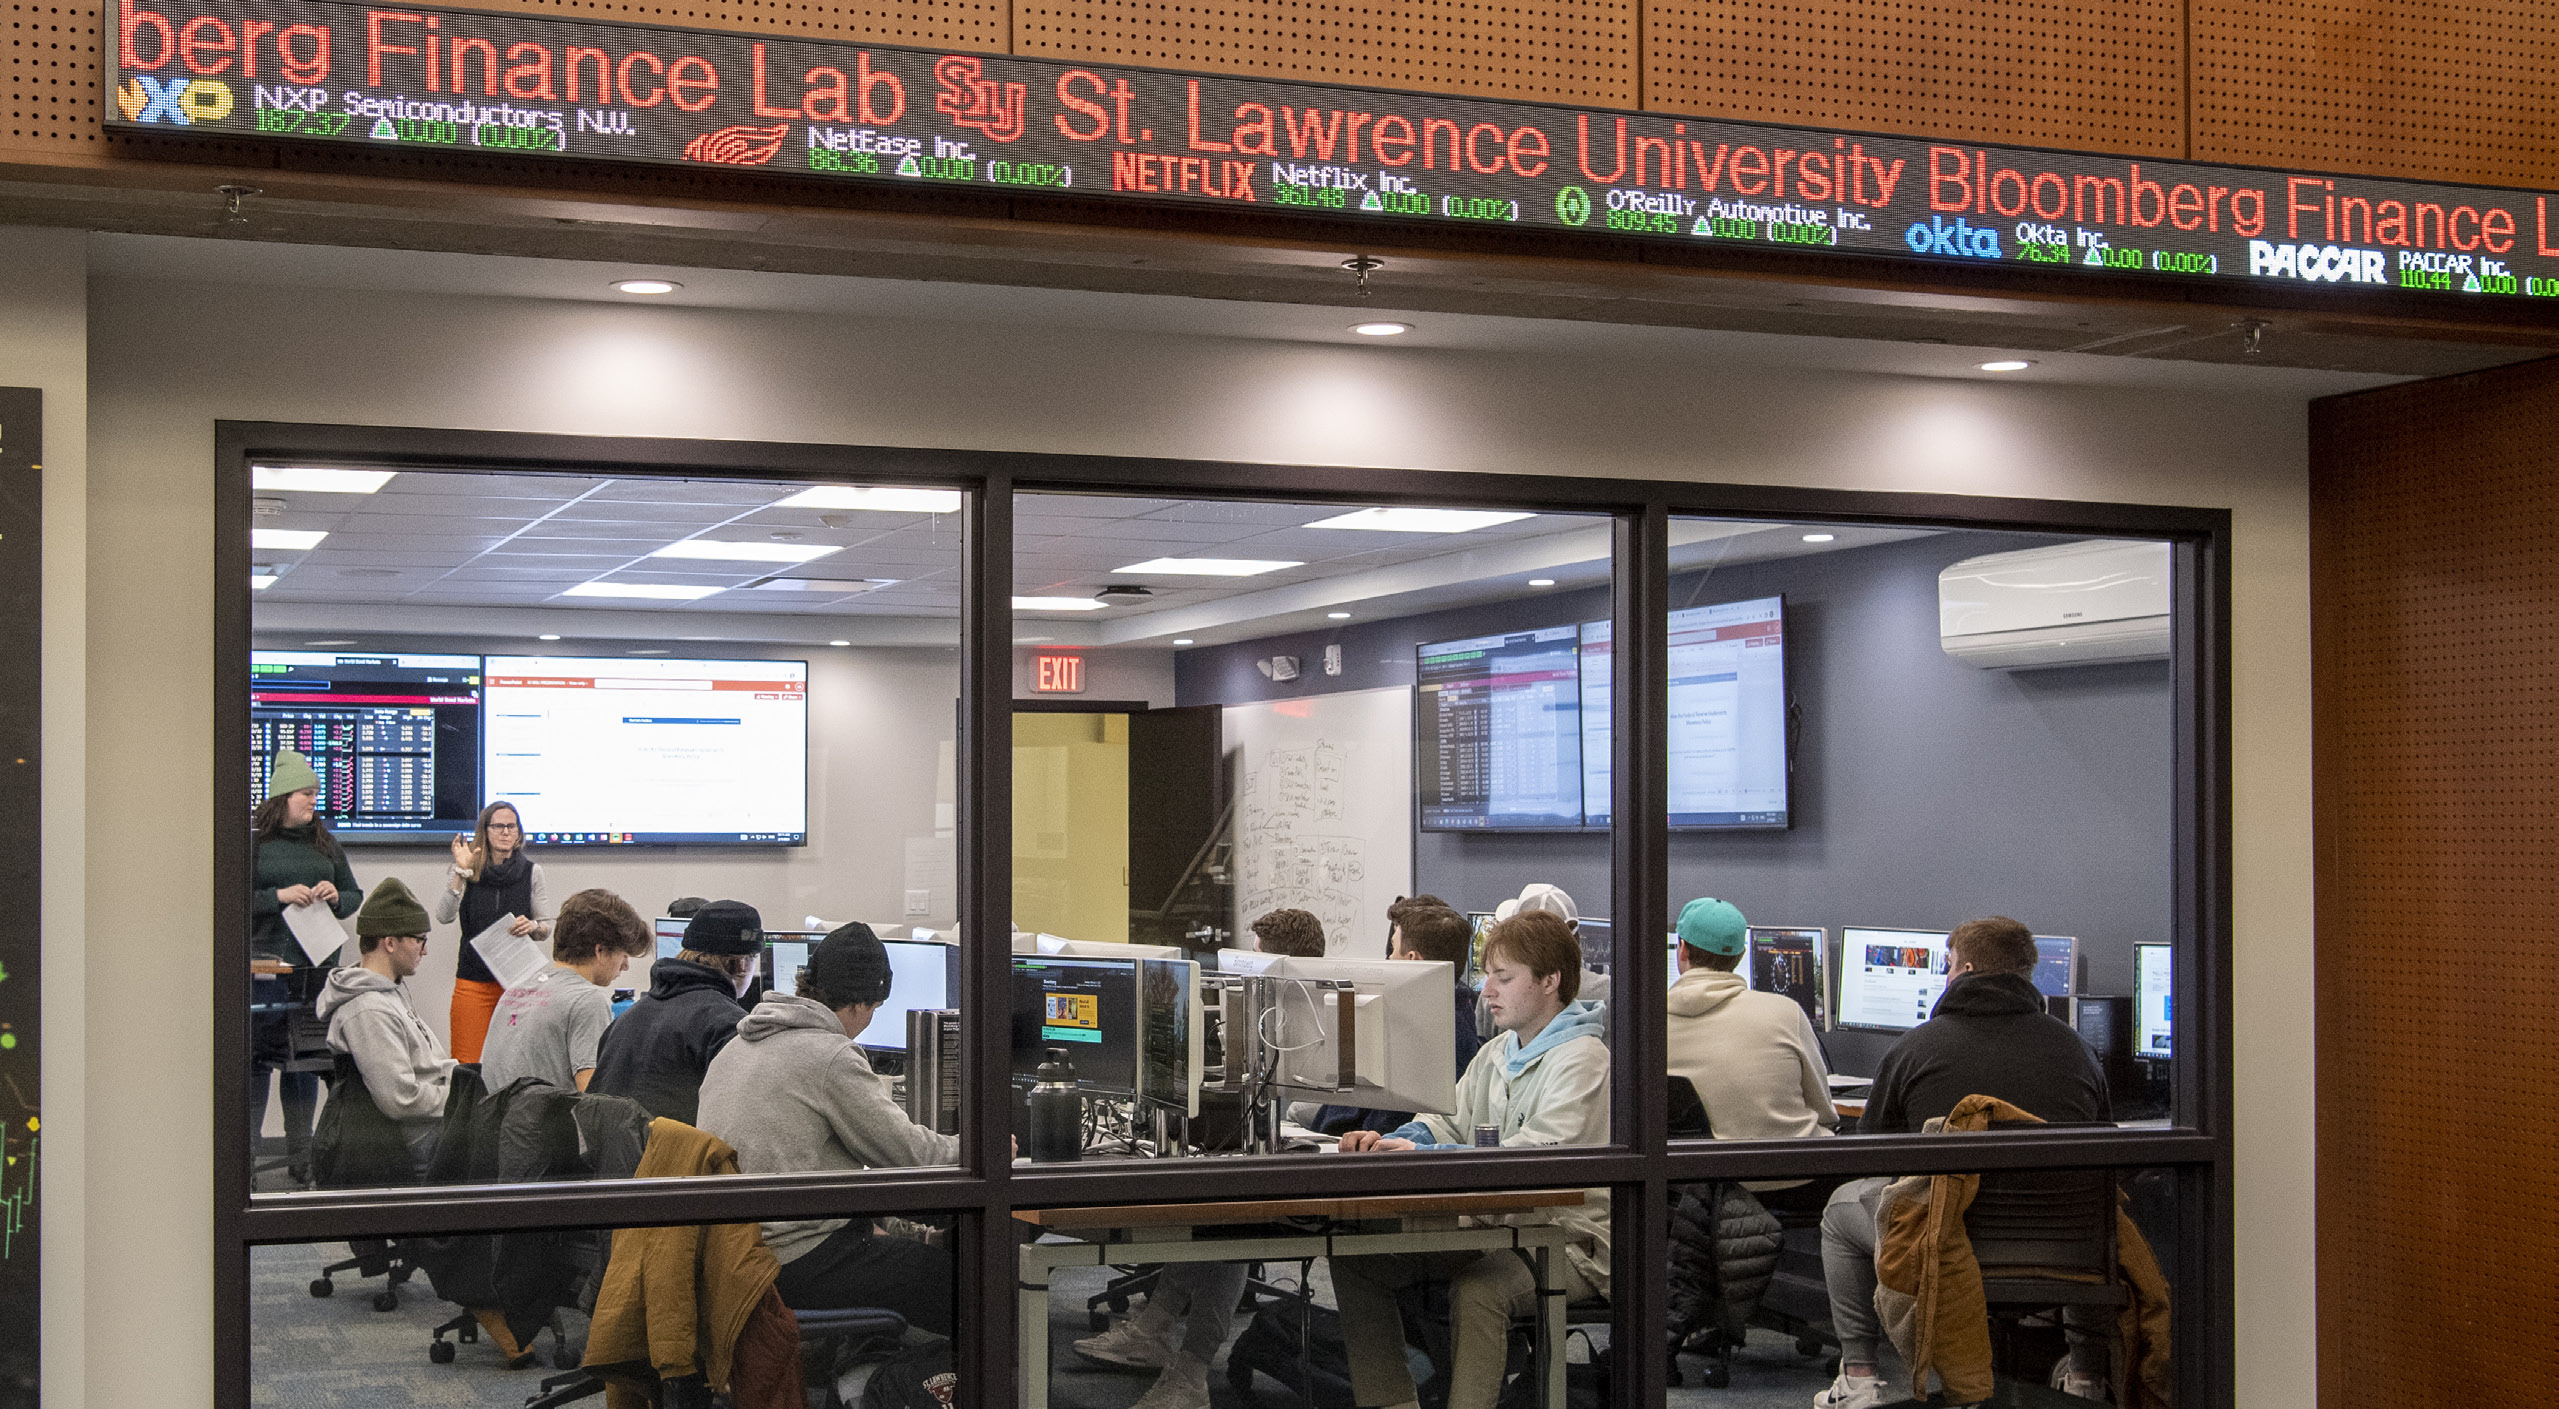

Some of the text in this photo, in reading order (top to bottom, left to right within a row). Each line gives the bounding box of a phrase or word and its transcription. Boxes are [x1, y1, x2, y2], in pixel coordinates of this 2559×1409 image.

[120, 0, 331, 85] berg
[367, 10, 719, 111] Finance
[753, 43, 905, 125] Lab
[1054, 69, 1153, 145] St.
[1187, 80, 1550, 177] Lawrence
[1578, 114, 1906, 208] University
[1929, 146, 2266, 238] Bloomberg
[2287, 176, 2516, 253] Finance
[254, 84, 328, 112] NXP
[343, 91, 564, 131] Semiconductors
[256, 108, 566, 152] 187.37 0.00 (0.00%)
[808, 126, 977, 160] NetEase Inc.
[808, 147, 1072, 188] 88.36 0.00 (0.00%)
[1112, 151, 1257, 202] NETFLIX
[1272, 162, 1418, 194] Netflix Inc.
[1273, 182, 1519, 221] 361.48 0.00 (0.00%)
[1606, 189, 1872, 230] O'Reilly Automotive Inc.
[1606, 209, 1838, 246] 809.45 0.00 (0.00%)
[1905, 215, 2003, 259] okta
[2015, 222, 2110, 249] Okta Inc.
[2016, 240, 2219, 275] 76.34 0.00 (0.00%)
[2249, 240, 2388, 284] PACCAR
[2399, 250, 2512, 277] PACCAR Inc.
[2400, 268, 2452, 291] 110.44
[2480, 275, 2518, 295] 0.00
[1039, 656, 1080, 690] EXIT
